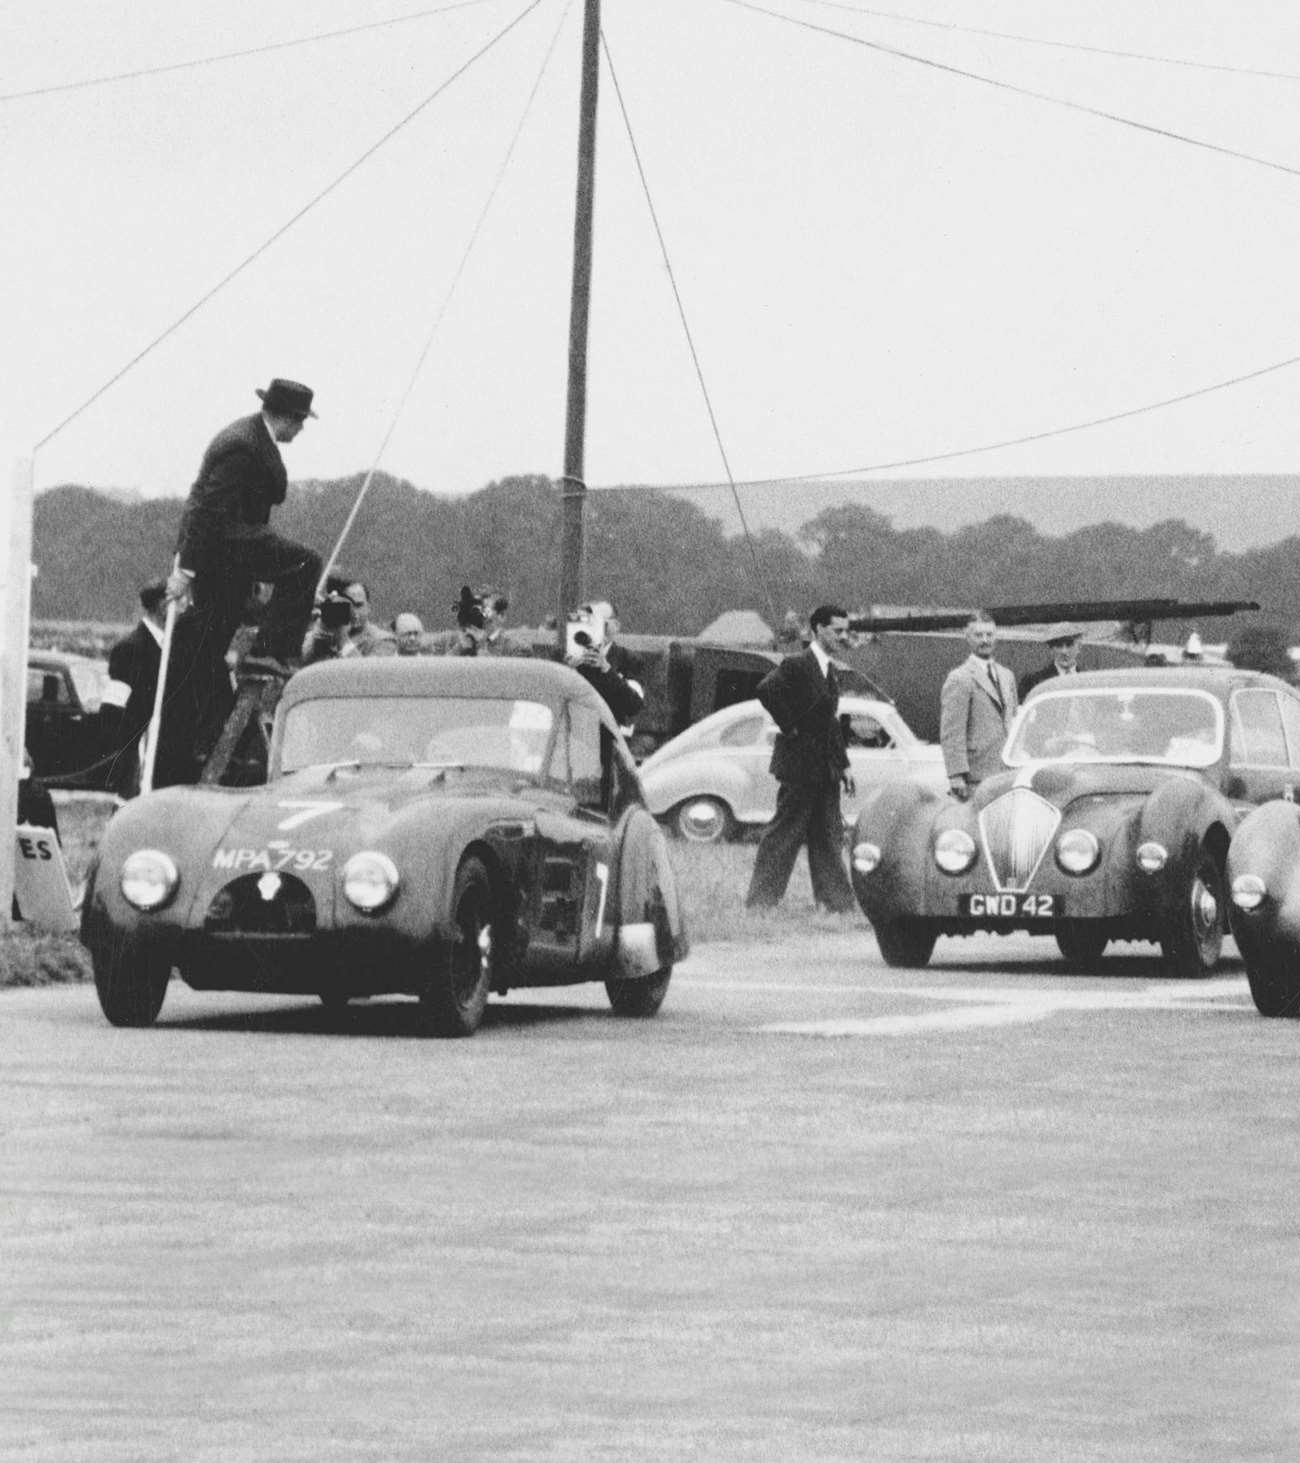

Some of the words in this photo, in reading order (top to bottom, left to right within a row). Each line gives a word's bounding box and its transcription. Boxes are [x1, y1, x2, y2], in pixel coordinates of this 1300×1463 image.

[277, 801, 344, 831] 7
[18, 837, 52, 861] ES
[969, 894, 1017, 916] GWD
[1022, 894, 1054, 917] 42
